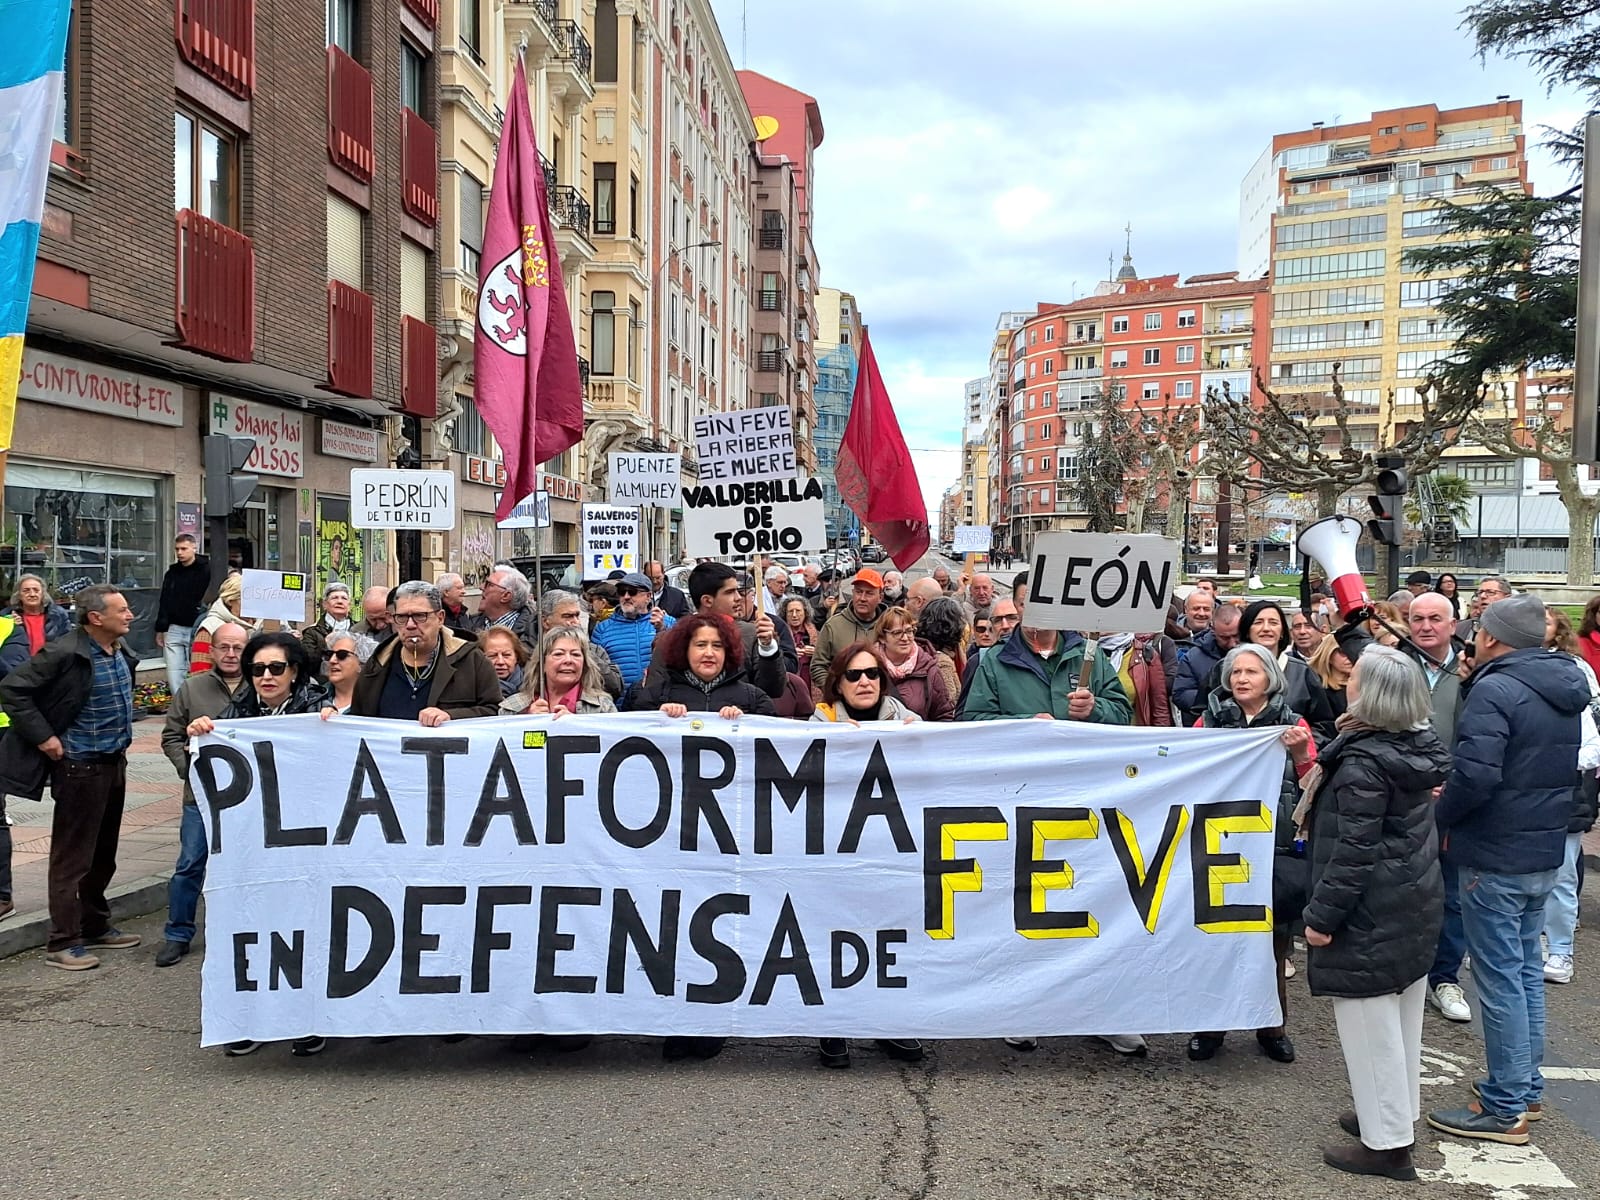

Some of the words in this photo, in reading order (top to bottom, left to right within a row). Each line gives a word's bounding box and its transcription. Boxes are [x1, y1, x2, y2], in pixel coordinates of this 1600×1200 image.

[694, 414, 736, 438] SIN
[740, 409, 791, 433] FEVE
[696, 441, 722, 459] LA
[725, 432, 794, 456] RIBERA
[616, 457, 676, 474] PUENTE
[699, 460, 728, 480] SE
[731, 451, 796, 477] MUERE
[364, 477, 448, 508] PEDRÚN
[615, 481, 677, 499] ALMUHEY
[682, 477, 823, 509] VALDERILLA
[367, 511, 380, 522] DE
[384, 510, 431, 523] TORIO
[590, 525, 634, 535] NUESTRO
[743, 505, 774, 530] DE
[588, 539, 612, 550] TREN
[616, 540, 630, 550] DE
[714, 527, 803, 555] TORIO
[1029, 544, 1171, 610] LEÓN
[194, 734, 918, 856] PLATAFORMA
[233, 930, 305, 992] EN
[326, 885, 825, 1006] DEFENSA
[831, 929, 908, 989] DE
[923, 800, 1274, 941] FEVE
